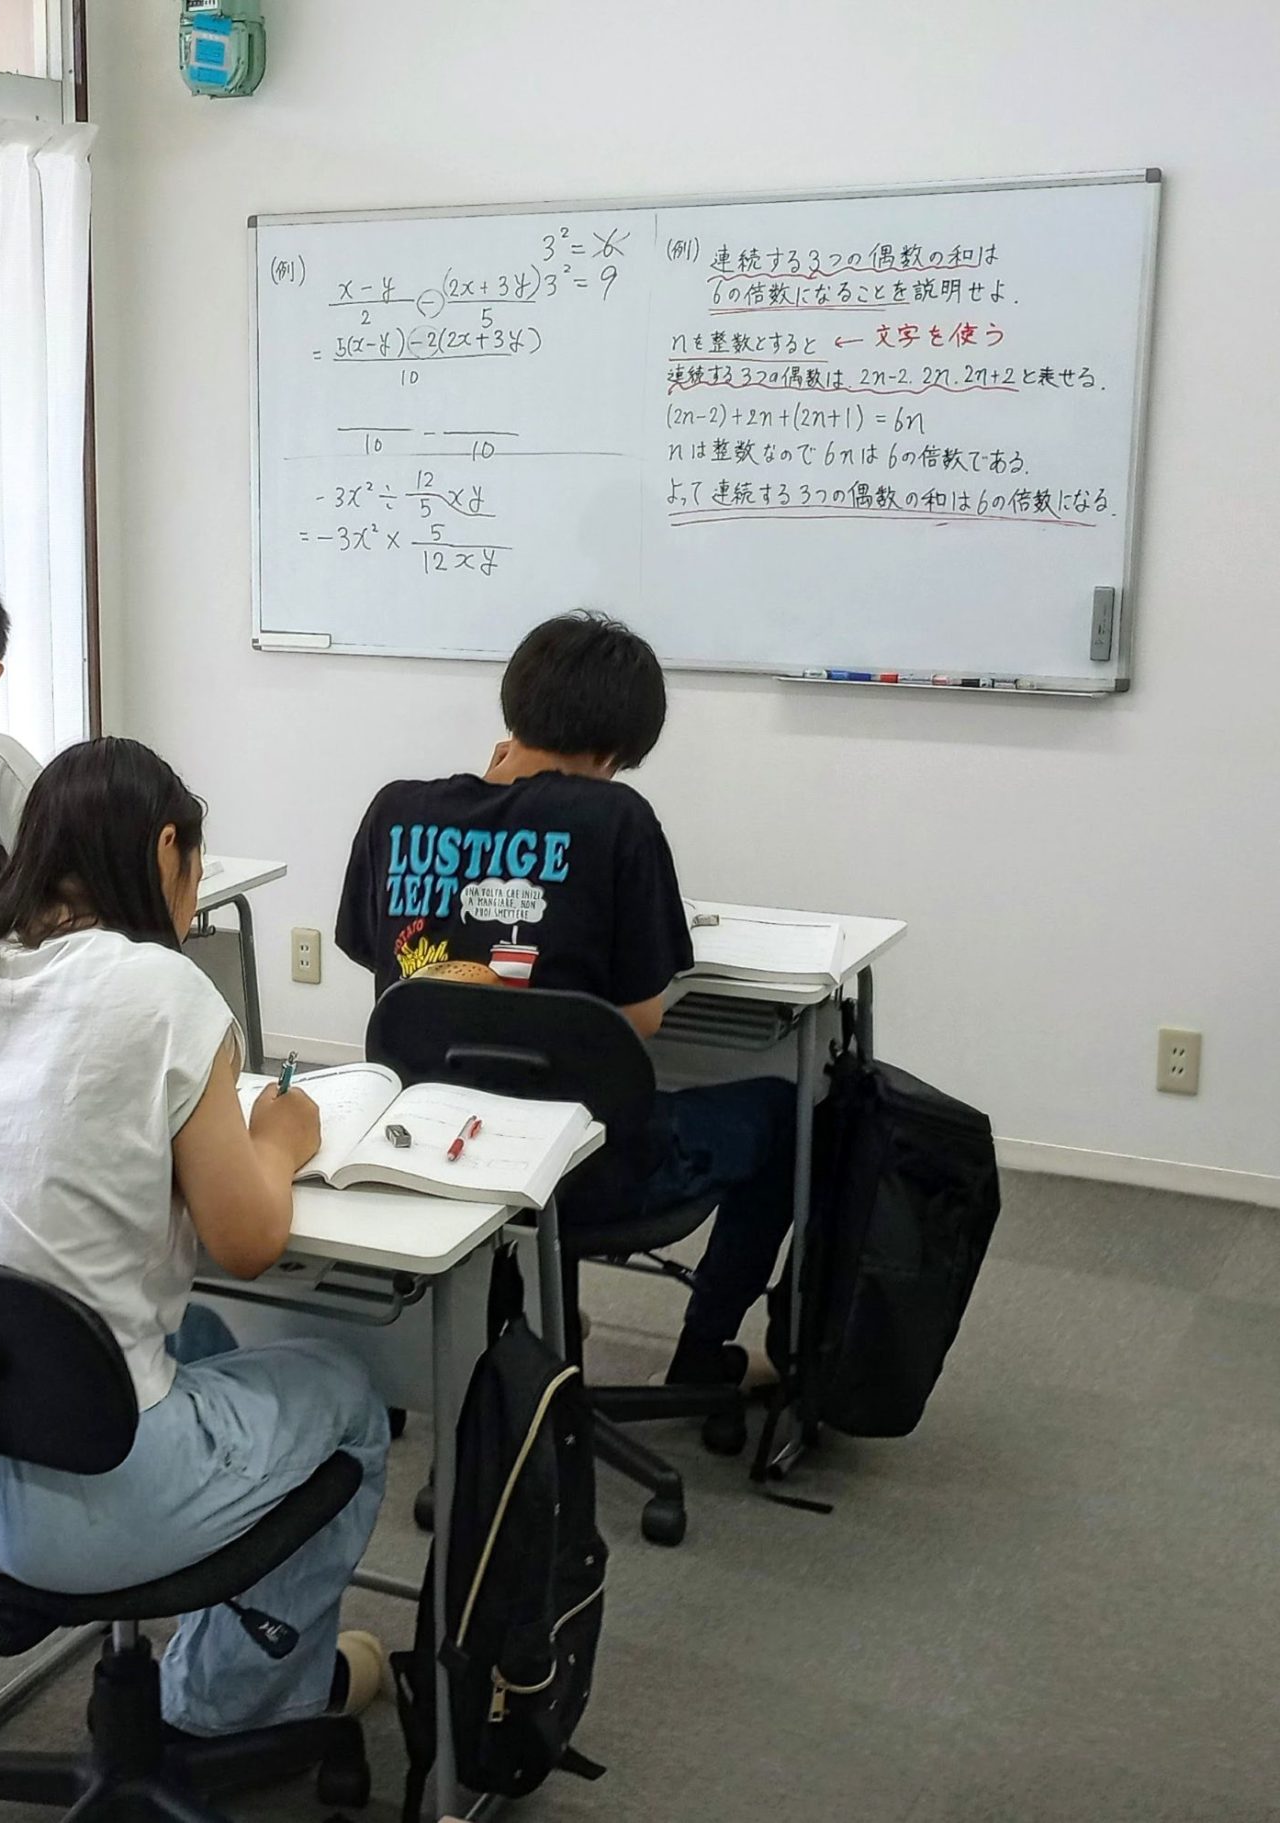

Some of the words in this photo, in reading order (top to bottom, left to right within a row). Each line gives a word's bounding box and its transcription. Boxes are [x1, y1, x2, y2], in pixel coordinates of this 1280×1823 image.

[875, 322, 1004, 348] 文字を使う
[387, 824, 571, 882] LUSTIGE
[387, 874, 459, 918] ZEIT
